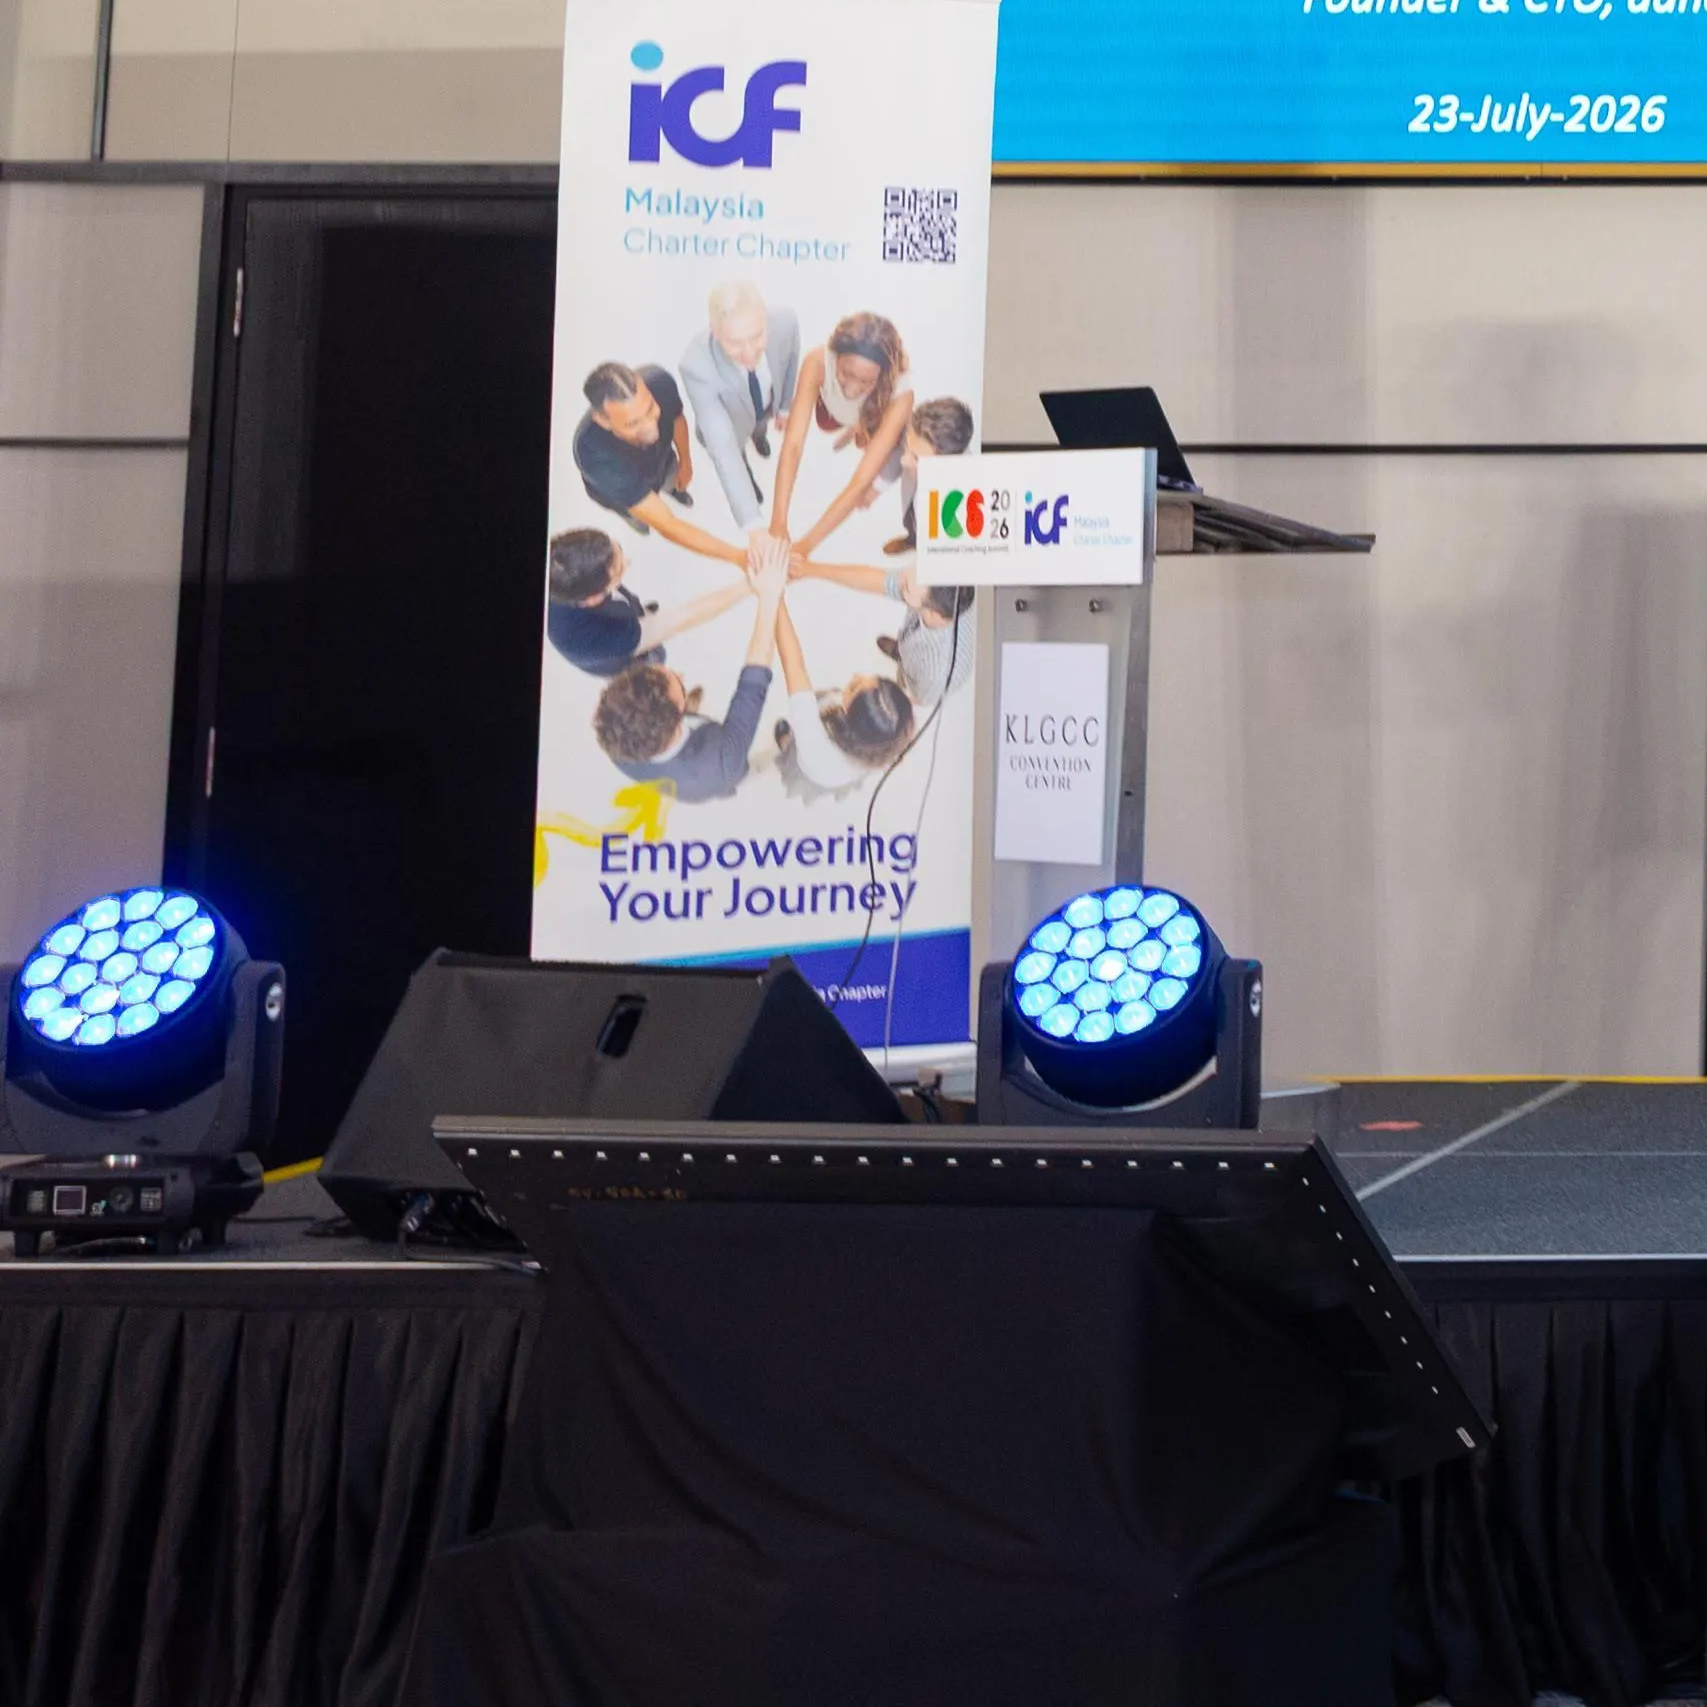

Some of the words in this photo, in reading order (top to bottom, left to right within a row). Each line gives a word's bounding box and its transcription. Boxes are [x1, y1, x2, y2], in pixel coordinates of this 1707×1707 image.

[1409, 94, 1666, 140] 23-July-2026
[624, 187, 765, 223] Malaysia
[623, 228, 729, 257] Charter
[736, 233, 850, 266] Chapter
[1004, 715, 1099, 747] KLGCC
[1010, 754, 1091, 772] CONVENTION
[600, 825, 918, 881] Empowering
[599, 881, 713, 923] Your
[724, 876, 917, 920] Journey
